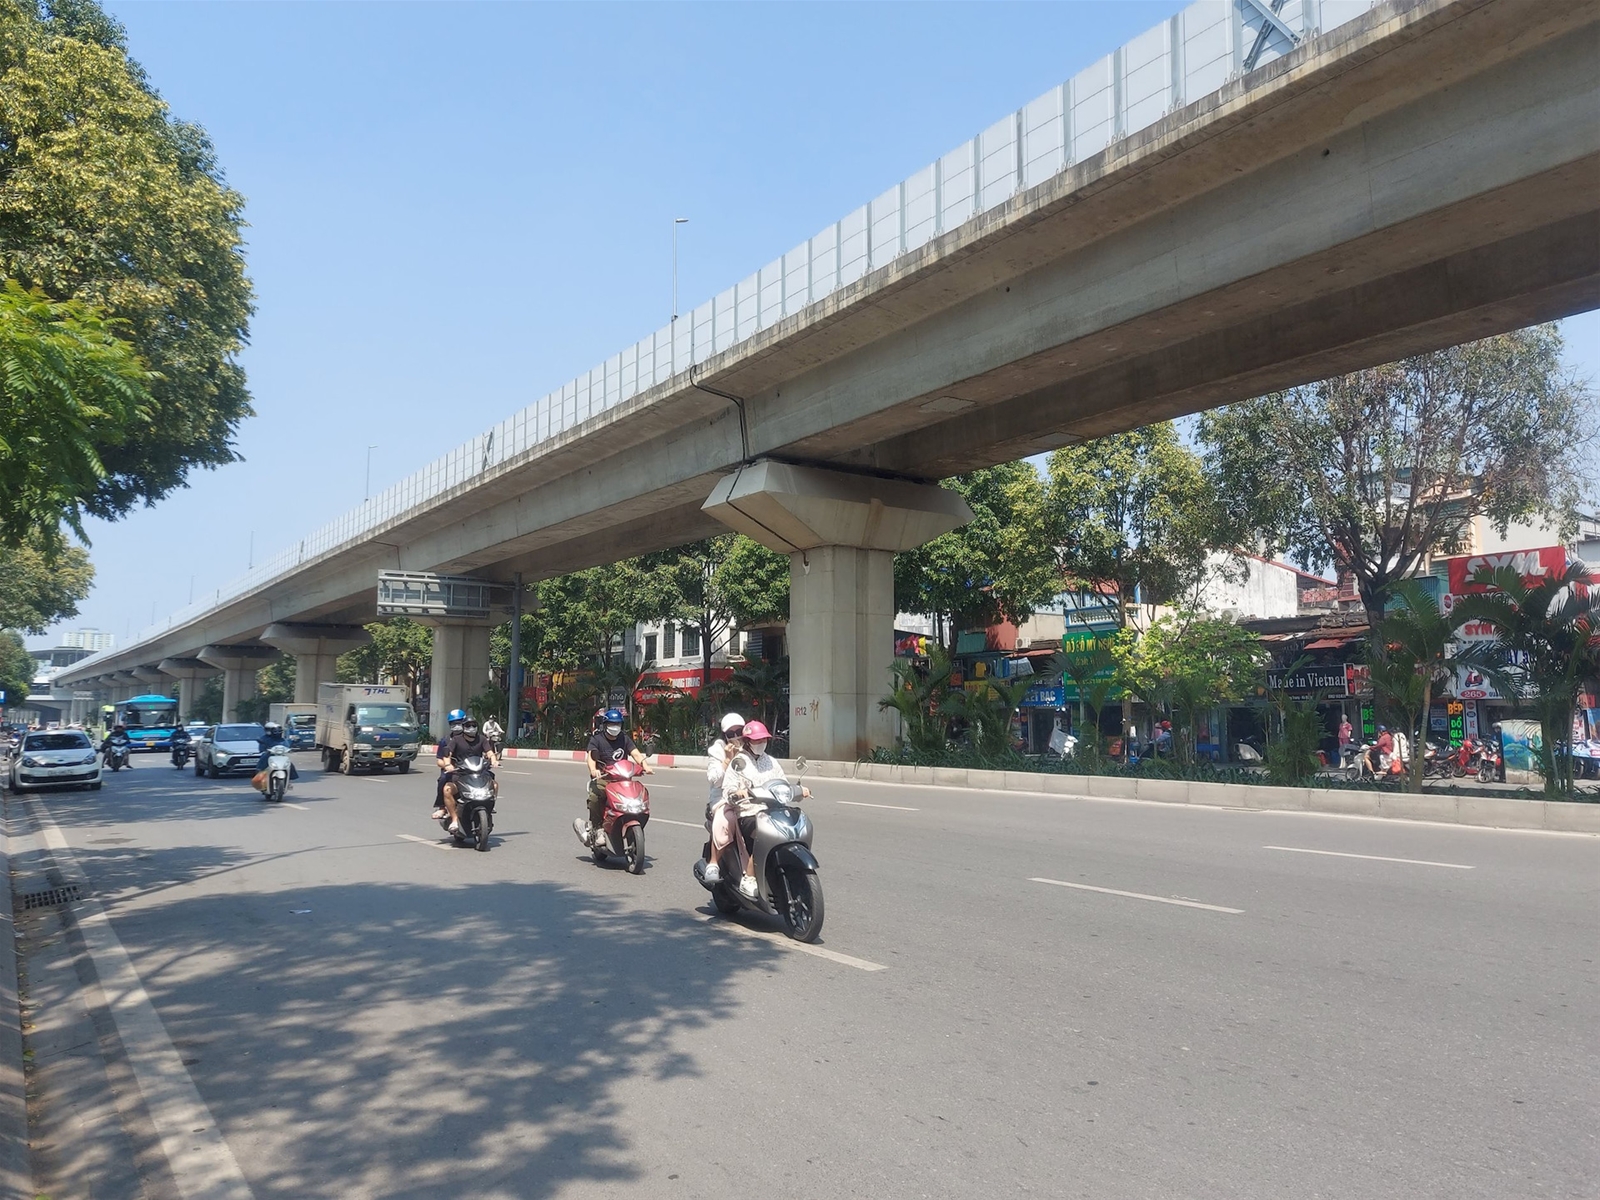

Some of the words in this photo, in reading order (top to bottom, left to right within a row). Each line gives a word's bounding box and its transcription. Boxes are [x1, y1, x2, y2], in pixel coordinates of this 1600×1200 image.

[1465, 551, 1548, 588] SYM
[1464, 623, 1492, 636] SYM
[1269, 674, 1294, 689] Made
[1296, 674, 1306, 688] in
[1464, 690, 1483, 698] 265
[1448, 701, 1464, 715] BẾP
